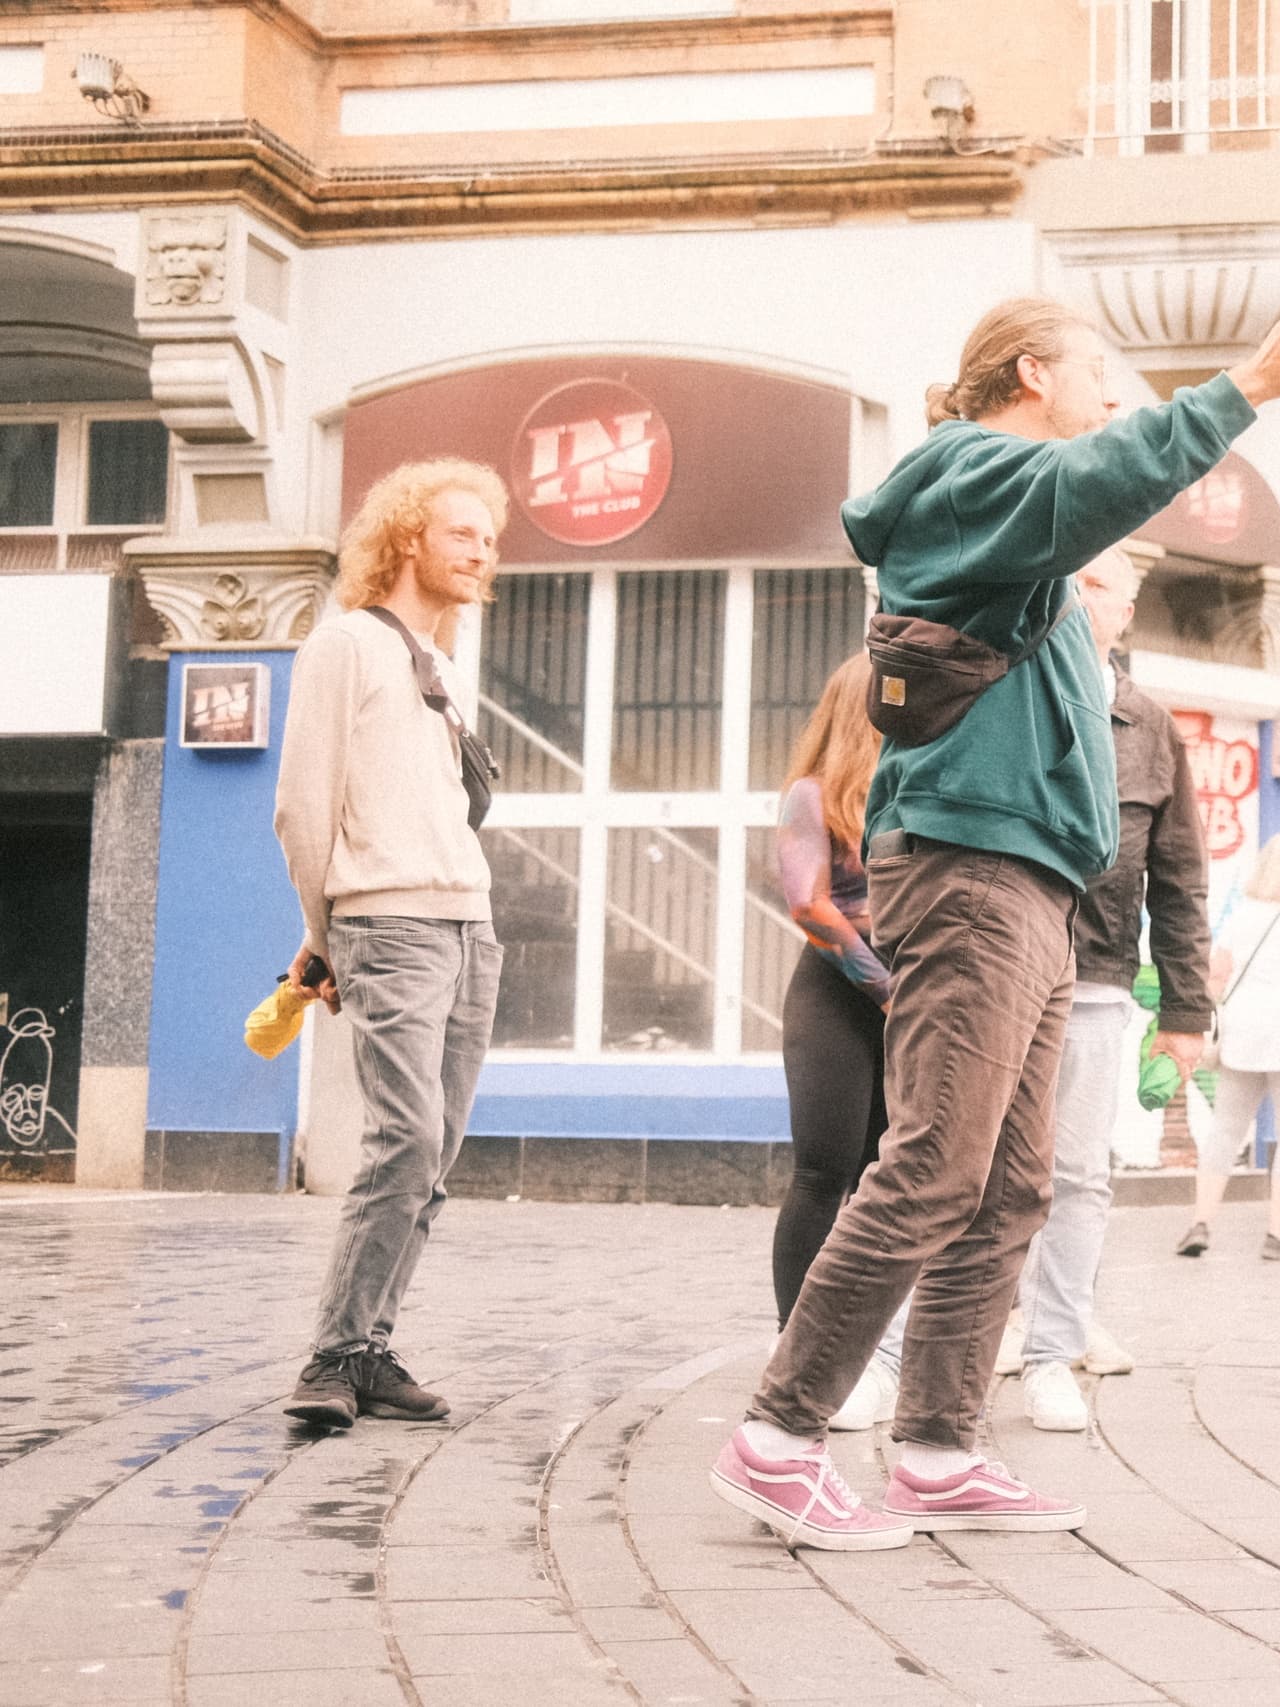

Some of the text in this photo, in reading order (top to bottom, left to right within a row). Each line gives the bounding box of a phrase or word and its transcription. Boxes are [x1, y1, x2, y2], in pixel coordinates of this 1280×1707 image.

[527, 411, 656, 507] IN
[571, 496, 641, 518] THE CLUB
[192, 682, 250, 728] IN
